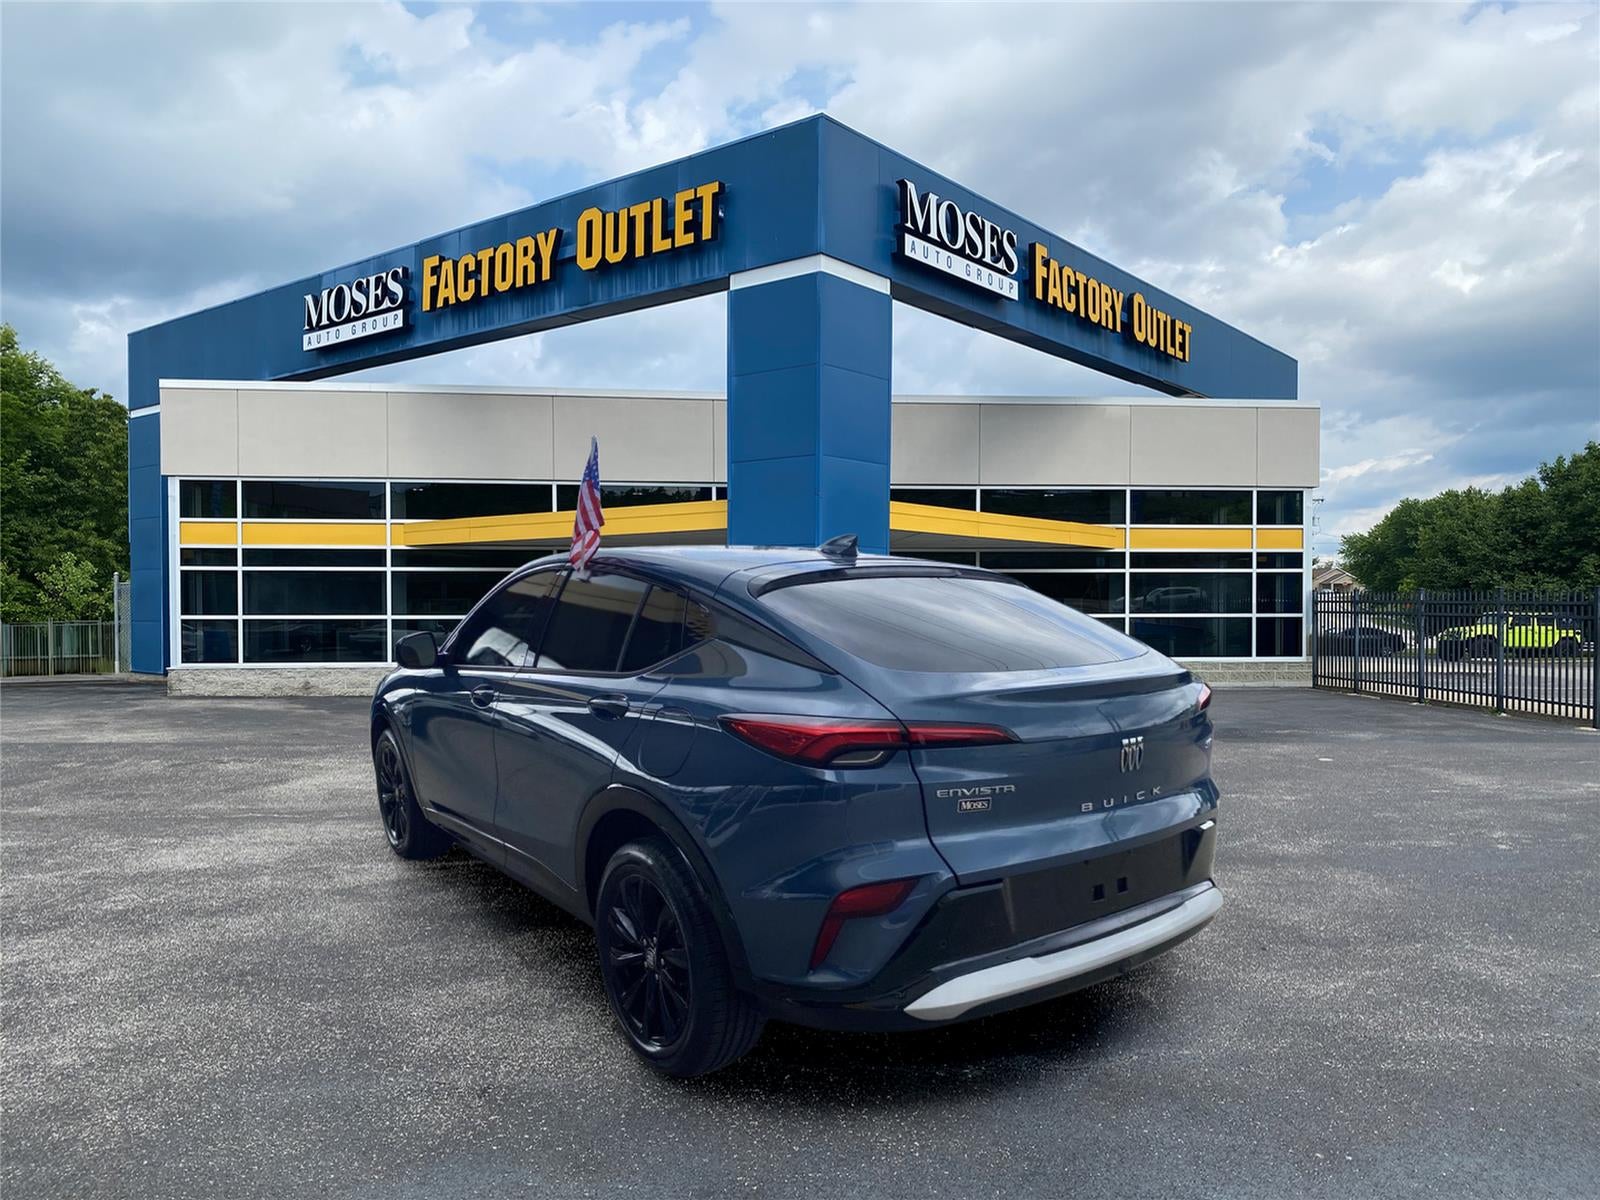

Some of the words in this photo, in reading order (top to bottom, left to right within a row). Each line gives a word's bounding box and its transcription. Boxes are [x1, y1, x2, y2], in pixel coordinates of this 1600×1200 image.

[422, 228, 559, 311] FACTORY
[577, 181, 721, 271] OUTLET
[904, 179, 1018, 275] MOSES
[910, 240, 953, 270] AUTO
[965, 263, 1015, 294] GROUP
[303, 267, 404, 330] MOSES
[1035, 242, 1124, 333] FACTORY
[1133, 292, 1192, 362] OUTLET
[307, 327, 341, 347] AUTO
[351, 314, 399, 334] GROUP
[936, 784, 1016, 798] ENVISTA
[1081, 786, 1161, 812] BUICK
